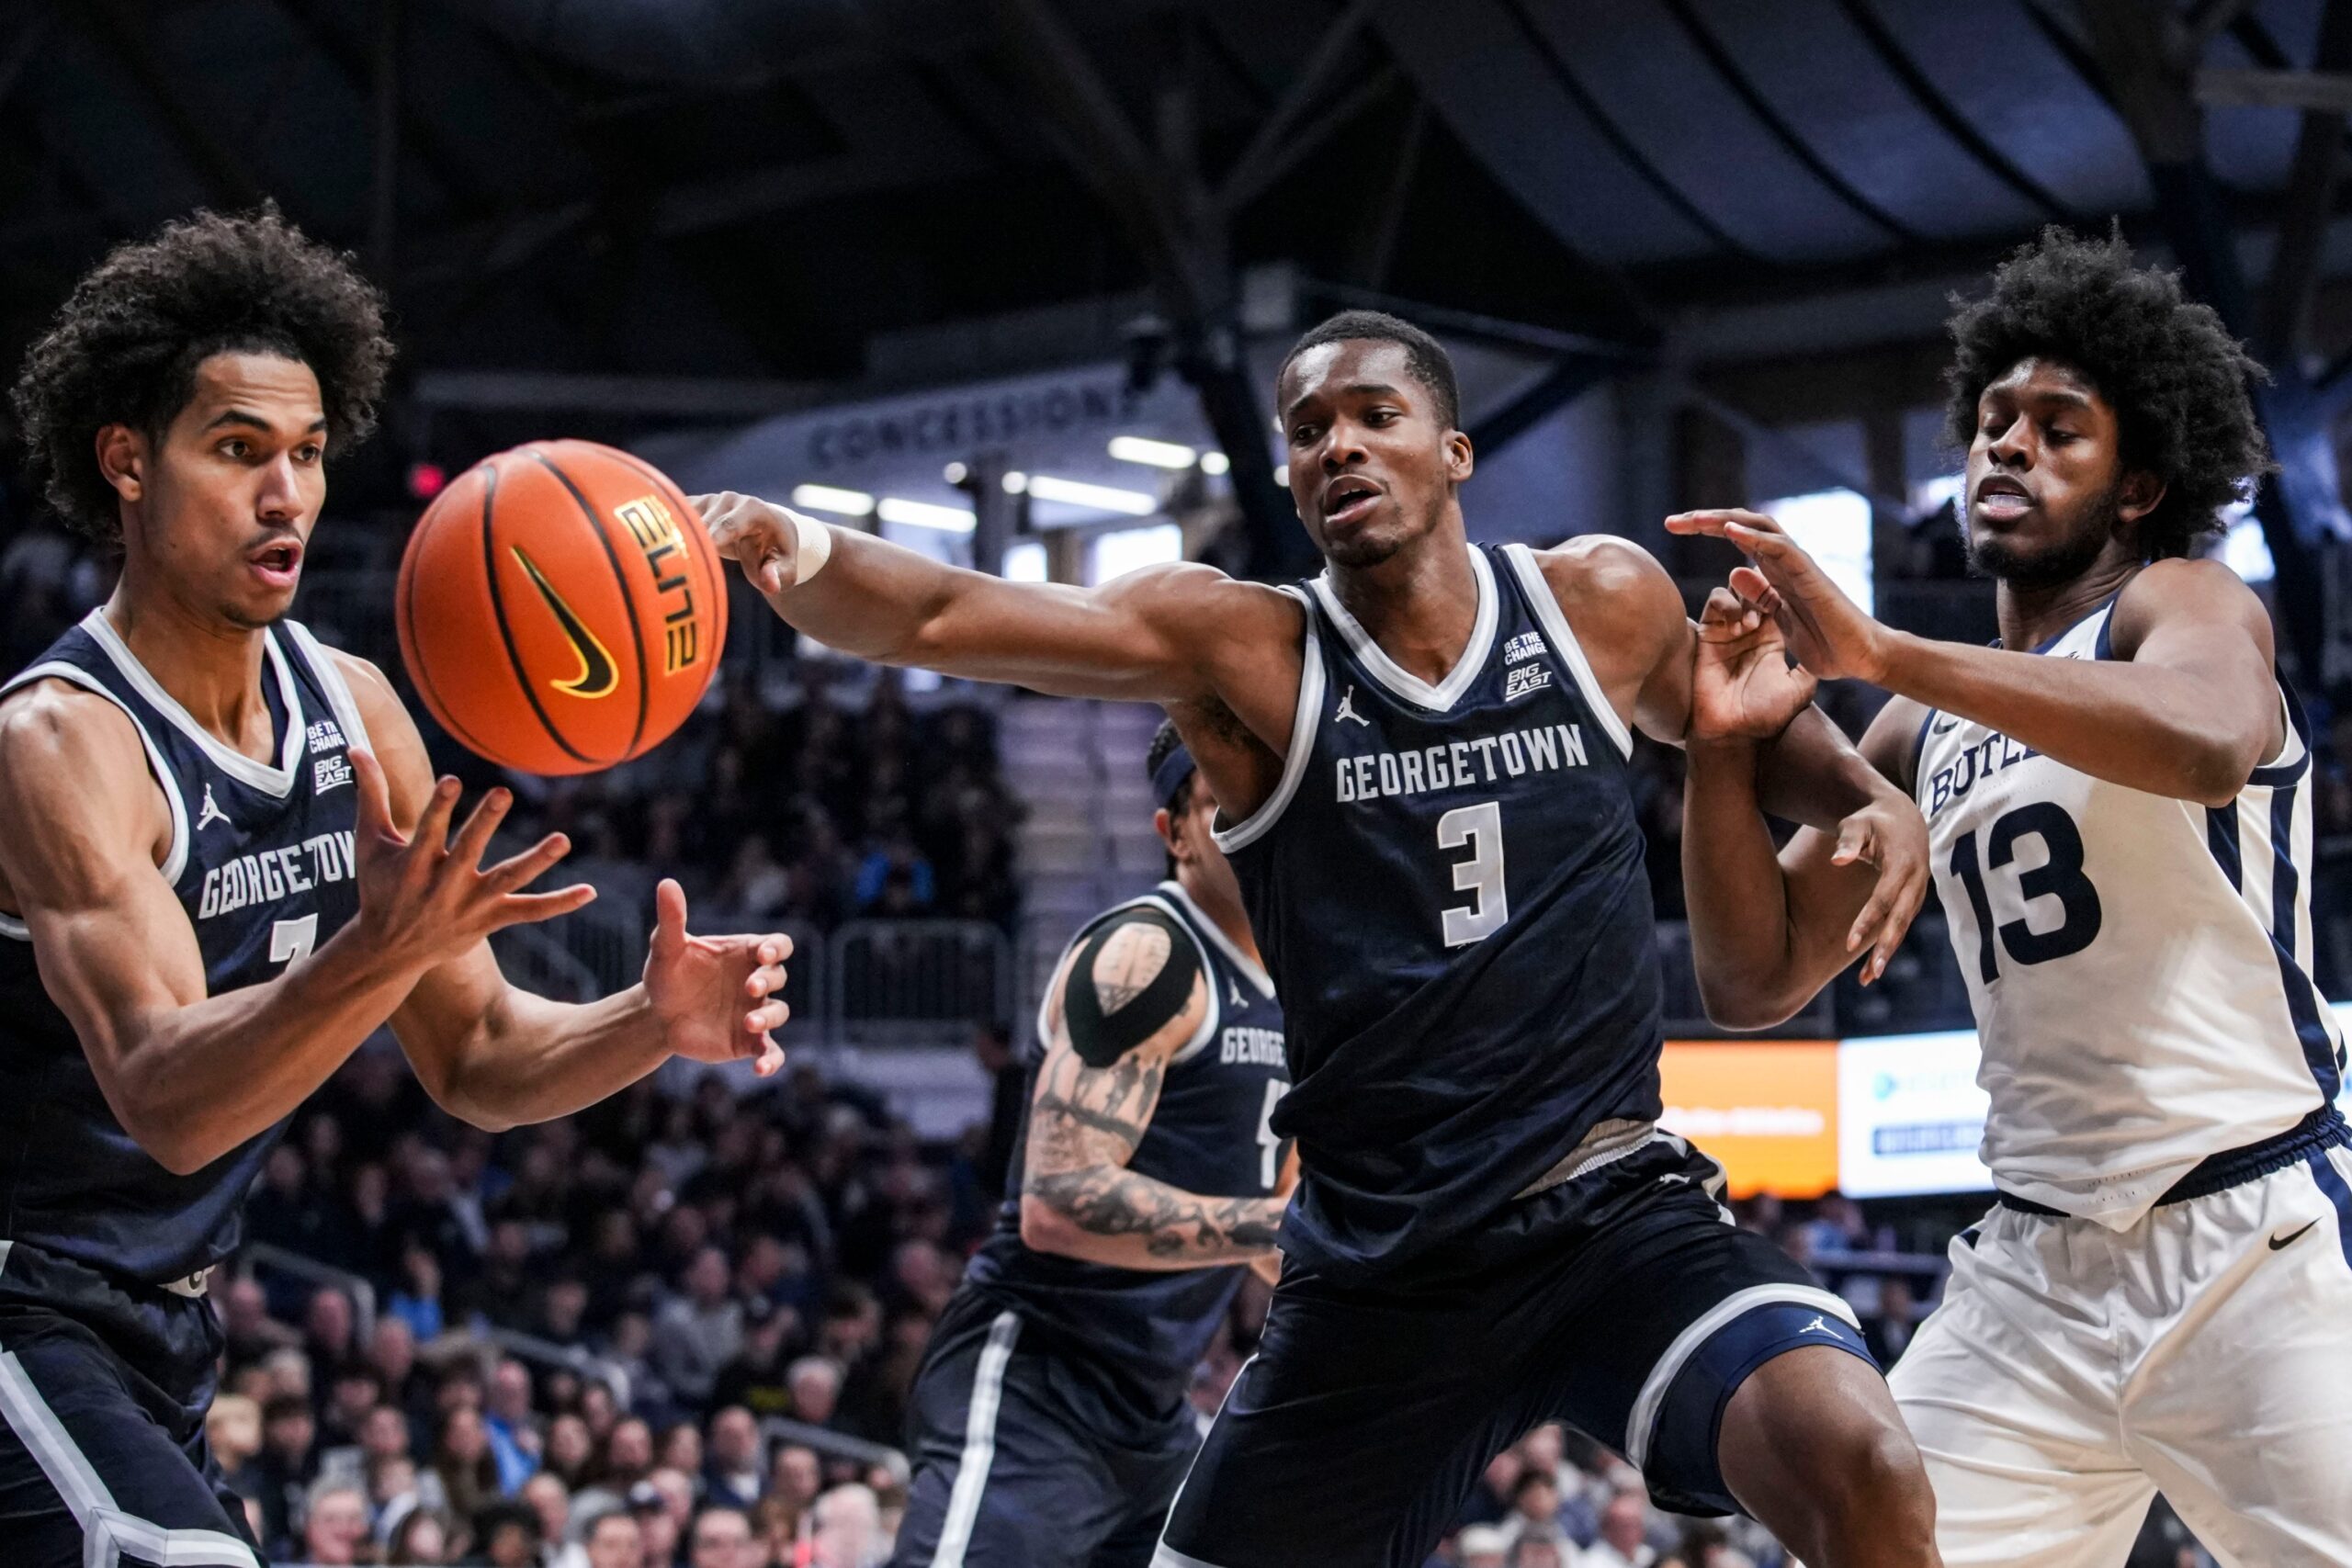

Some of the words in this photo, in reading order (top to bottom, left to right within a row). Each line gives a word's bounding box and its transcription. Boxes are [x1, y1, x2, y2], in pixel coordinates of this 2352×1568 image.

[617, 499, 698, 673] ELITE
[1504, 637, 1520, 654] BE
[1520, 631, 1541, 645] THE
[1504, 642, 1548, 666] CHANGE
[1506, 671, 1552, 696] EAST
[1508, 662, 1540, 684] BIG
[307, 721, 324, 740] BE
[314, 755, 342, 774] BIG
[1336, 724, 1589, 803] GEORGETOWN
[315, 766, 352, 788] EAST
[1437, 801, 1509, 947] 3
[1950, 801, 2102, 986] 13
[269, 912, 319, 974] 7
